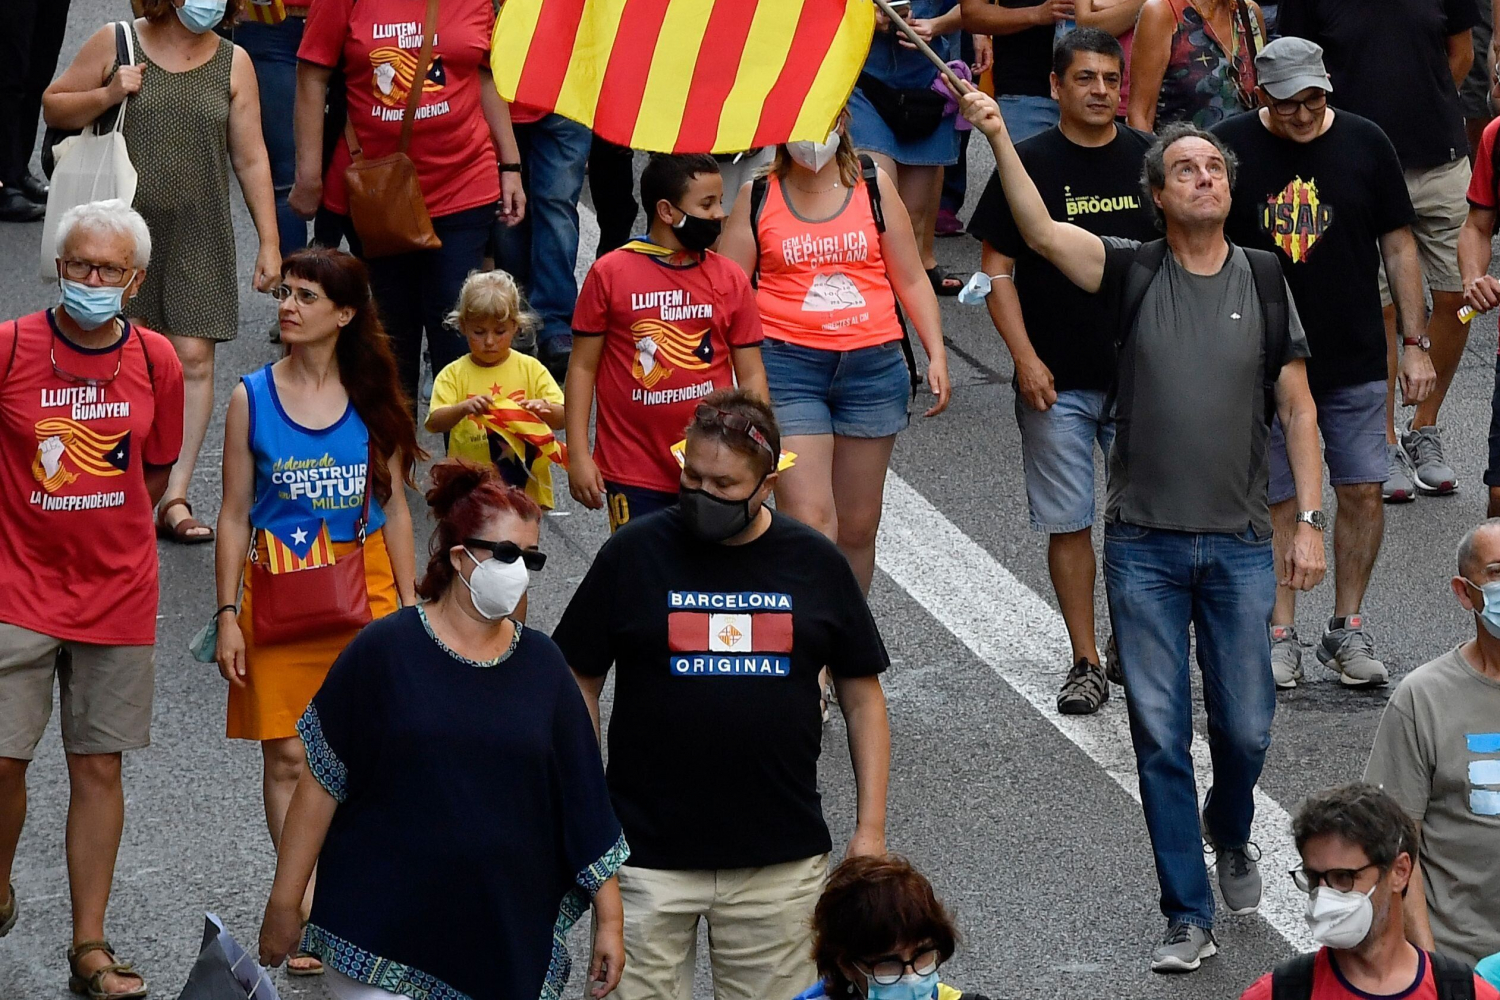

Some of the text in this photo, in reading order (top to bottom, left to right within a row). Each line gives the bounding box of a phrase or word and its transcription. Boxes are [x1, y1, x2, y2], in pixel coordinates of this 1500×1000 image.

[372, 21, 416, 40] LLUITEM
[371, 100, 450, 122] LA INDENDÈNCIA
[1066, 196, 1139, 216] BRÒQUIL
[1257, 202, 1334, 236] USAP
[782, 236, 804, 250] FEM
[782, 230, 869, 266] REPÚBLICA
[632, 289, 691, 311] LLUITEM I
[661, 303, 713, 322] GUANYEM
[41, 386, 106, 408] LLUITEM I
[631, 379, 714, 407] LA INDEPENDÈNCIA
[72, 402, 130, 422] GUANYEM
[271, 463, 367, 486] CONSTRUIR
[30, 490, 126, 512] LA INDEPENDÈNCIA
[670, 592, 791, 609] BARCELONA
[675, 658, 786, 676] ORIGINAL
